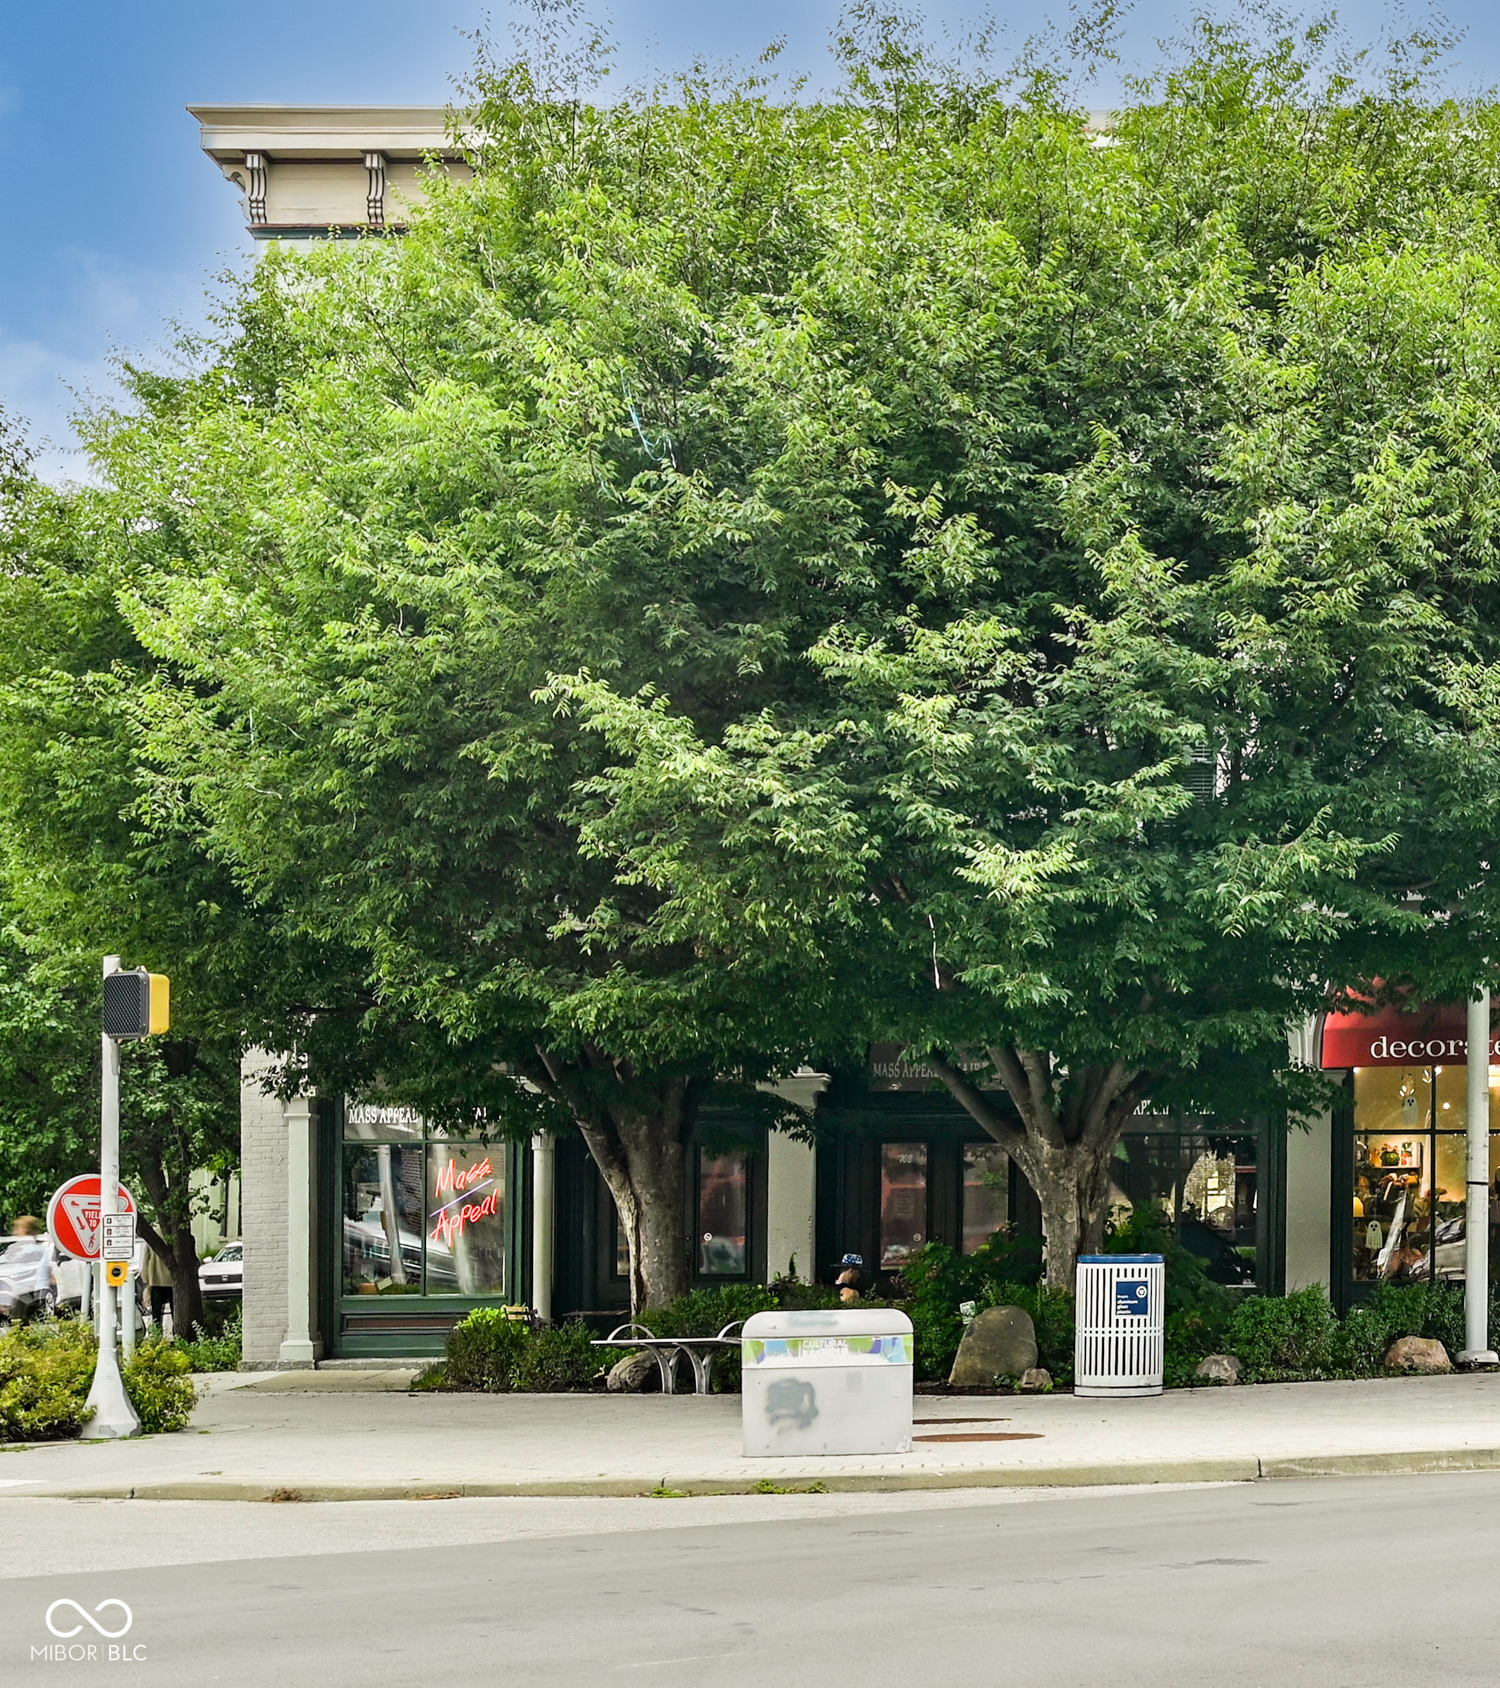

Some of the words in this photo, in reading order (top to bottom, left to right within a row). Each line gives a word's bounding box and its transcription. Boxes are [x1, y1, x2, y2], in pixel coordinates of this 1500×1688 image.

[873, 1063, 899, 1078] MASS
[902, 1063, 940, 1078] APPEA
[349, 1108, 377, 1124] MASS
[379, 1107, 418, 1124] APPEAL
[435, 1157, 493, 1198] Mass
[89, 1219, 97, 1228] TO
[429, 1188, 499, 1248] Appeal
[802, 1339, 848, 1349] CULTURAL
